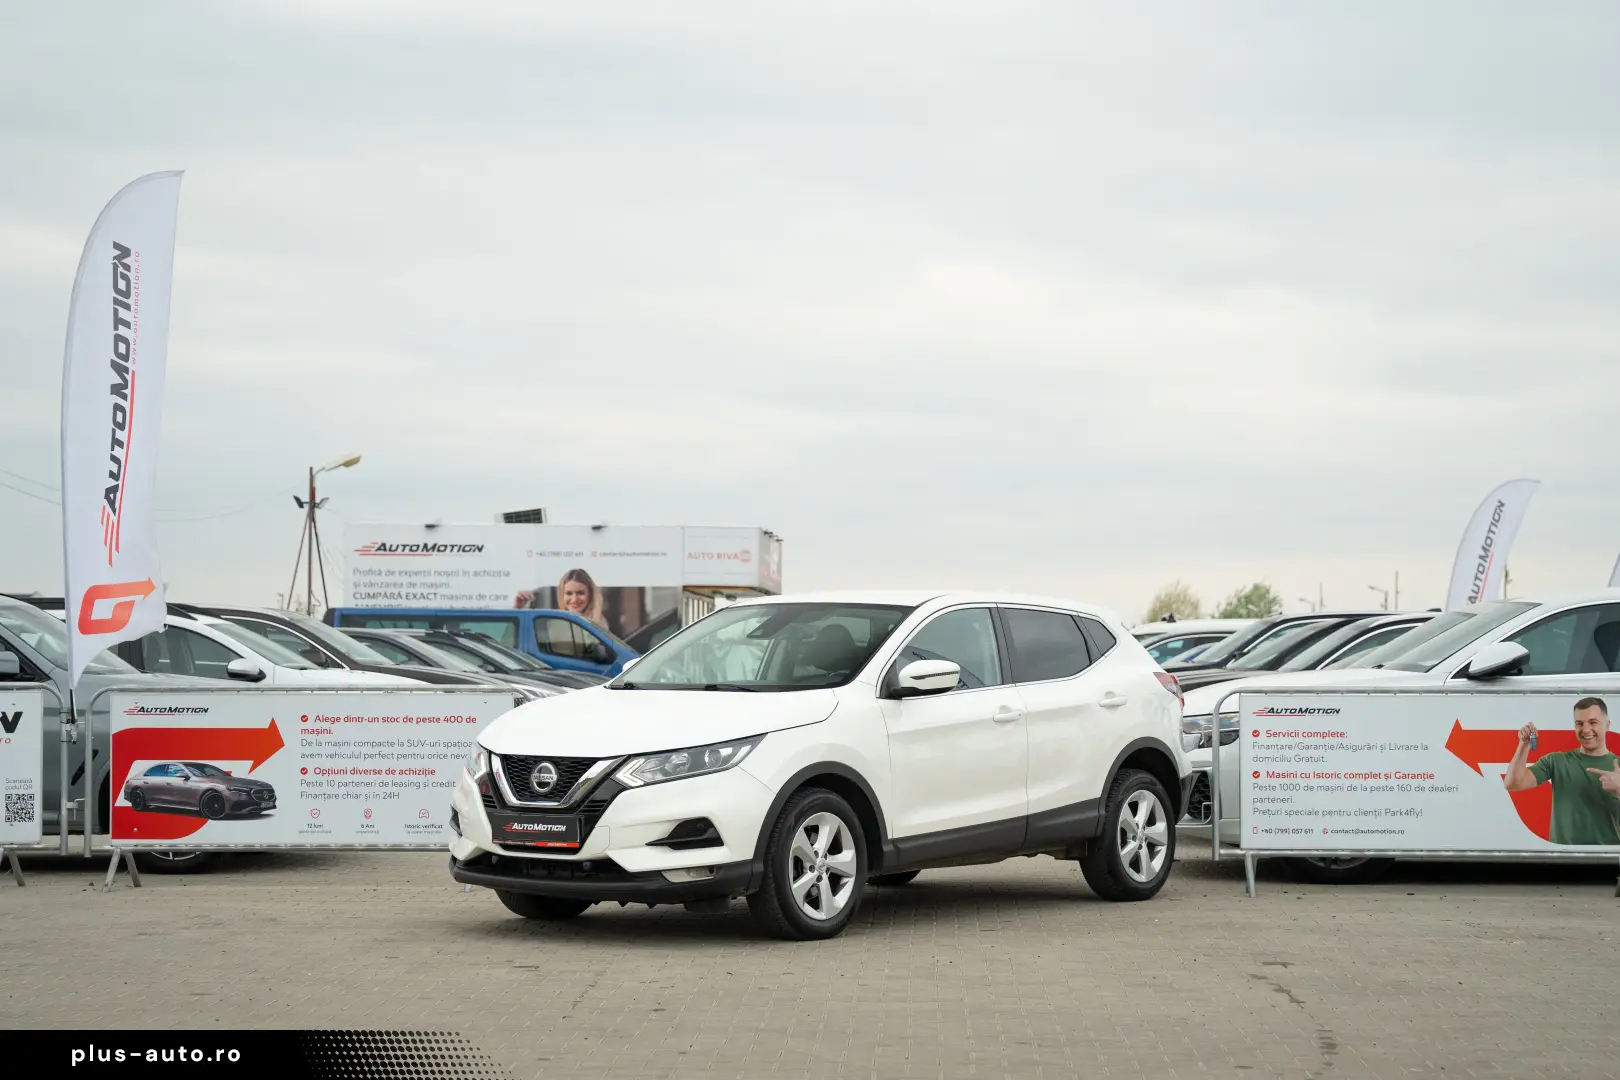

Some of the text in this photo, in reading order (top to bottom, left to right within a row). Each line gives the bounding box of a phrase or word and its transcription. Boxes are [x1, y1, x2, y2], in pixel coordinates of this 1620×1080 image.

[687, 552, 740, 560] AUTO RIVA
[384, 568, 396, 577] de
[353, 580, 360, 590] și
[362, 580, 403, 589] vânzarea
[406, 580, 418, 589] de
[405, 592, 438, 600] EXACT
[440, 592, 474, 603] mașina
[475, 592, 488, 601] de
[314, 715, 477, 725] Alege dintr-un stoc de peste 400 de
[300, 727, 334, 736] mașini.
[1266, 730, 1348, 740] Servicii complete:
[300, 739, 313, 747] De
[316, 739, 322, 747] la
[324, 739, 351, 749] mașini
[353, 740, 396, 750] compacte
[398, 740, 405, 748] la
[407, 740, 440, 748] SUV-uri
[1252, 742, 1428, 753] Finanțare/Garanție/Asigurări și Livrare la
[325, 751, 362, 760] vehiculul
[364, 751, 394, 761] perfect
[396, 752, 425, 761] pentru
[428, 752, 448, 760] orice
[1252, 754, 1328, 763] domiciliu Gratuit.
[314, 766, 436, 777] Opțiuni diverse de achiziție
[1314, 770, 1342, 780] Istoric
[1344, 770, 1382, 782] complet
[1384, 772, 1392, 782] și
[1394, 771, 1435, 782] Garanție
[300, 780, 456, 790] Peste 10 parteneri de leasing și credit
[1252, 783, 1458, 794] Peste 1000 de mașini de la peste 160 de dealeri
[300, 792, 400, 802] Finanțare chiar și în 24H
[1252, 796, 1295, 806] parteneri.
[1253, 808, 1423, 819] Prețuri speciale pentru clienții Park4fly!
[512, 822, 566, 832] AUTOMOTION
